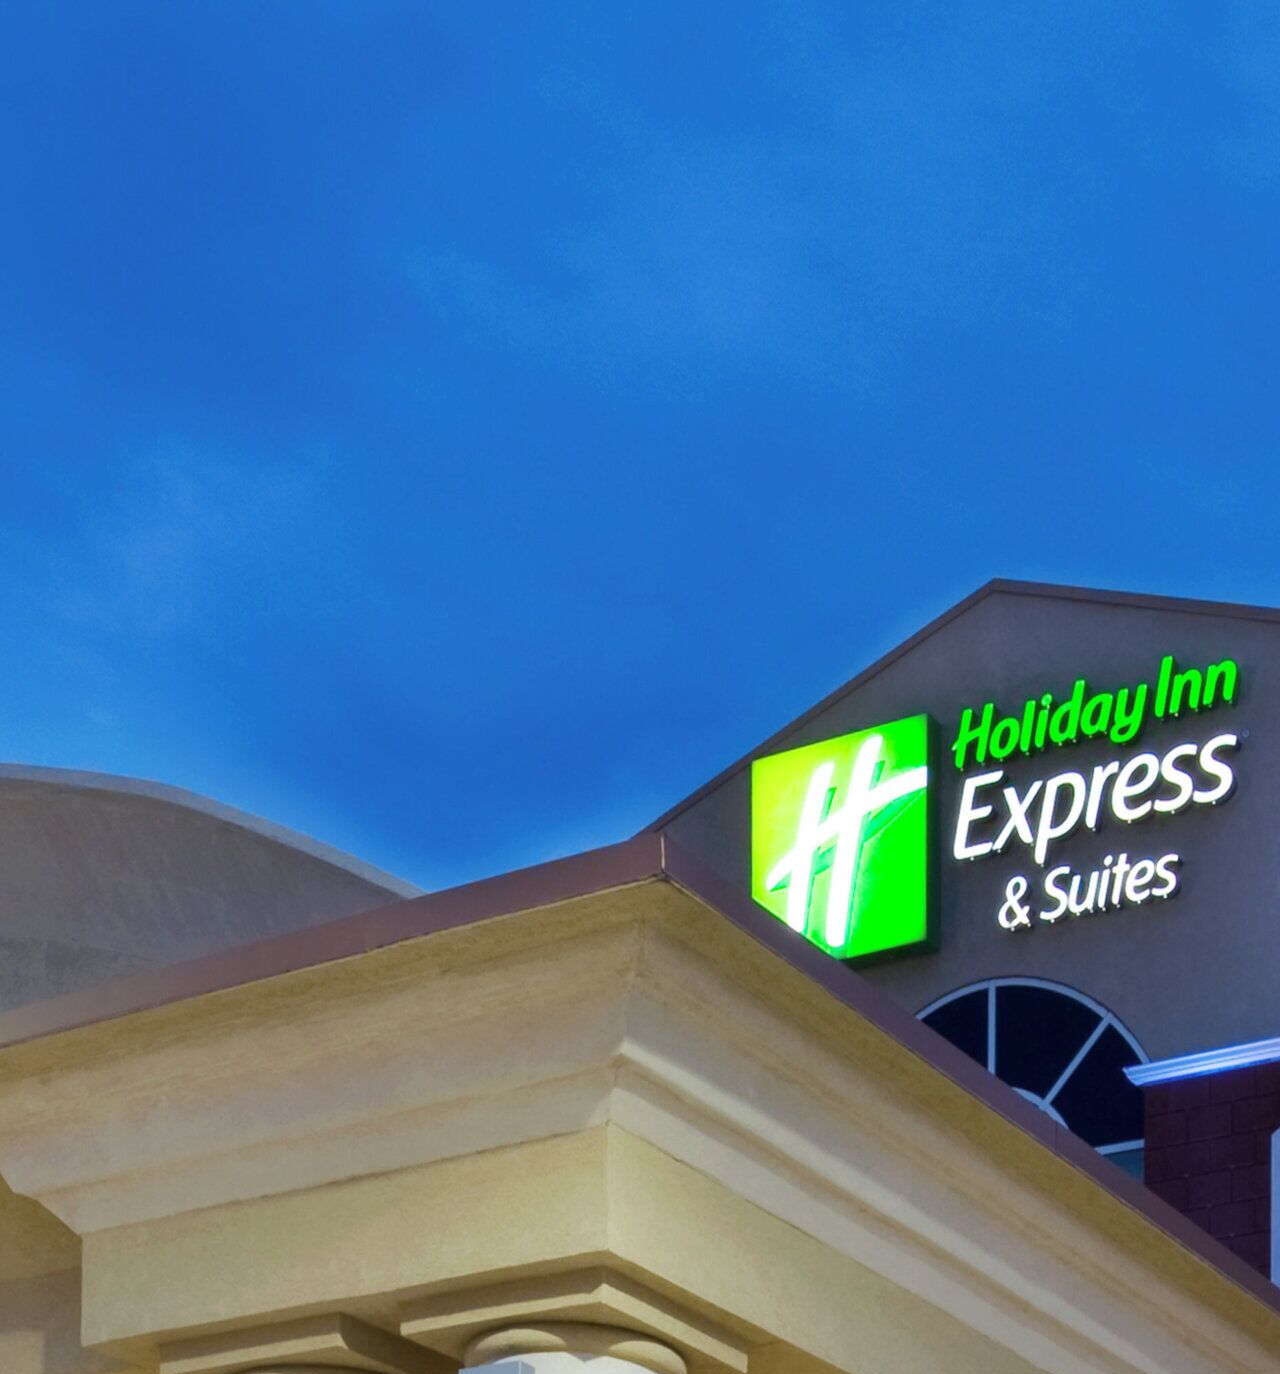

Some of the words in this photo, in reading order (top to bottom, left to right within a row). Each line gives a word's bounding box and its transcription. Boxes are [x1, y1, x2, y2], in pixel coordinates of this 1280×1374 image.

[951, 679, 1148, 769] Holiday
[1154, 655, 1238, 718] Inn
[952, 733, 1238, 865] Express
[997, 875, 1031, 929] &
[1039, 852, 1180, 921] Suites
